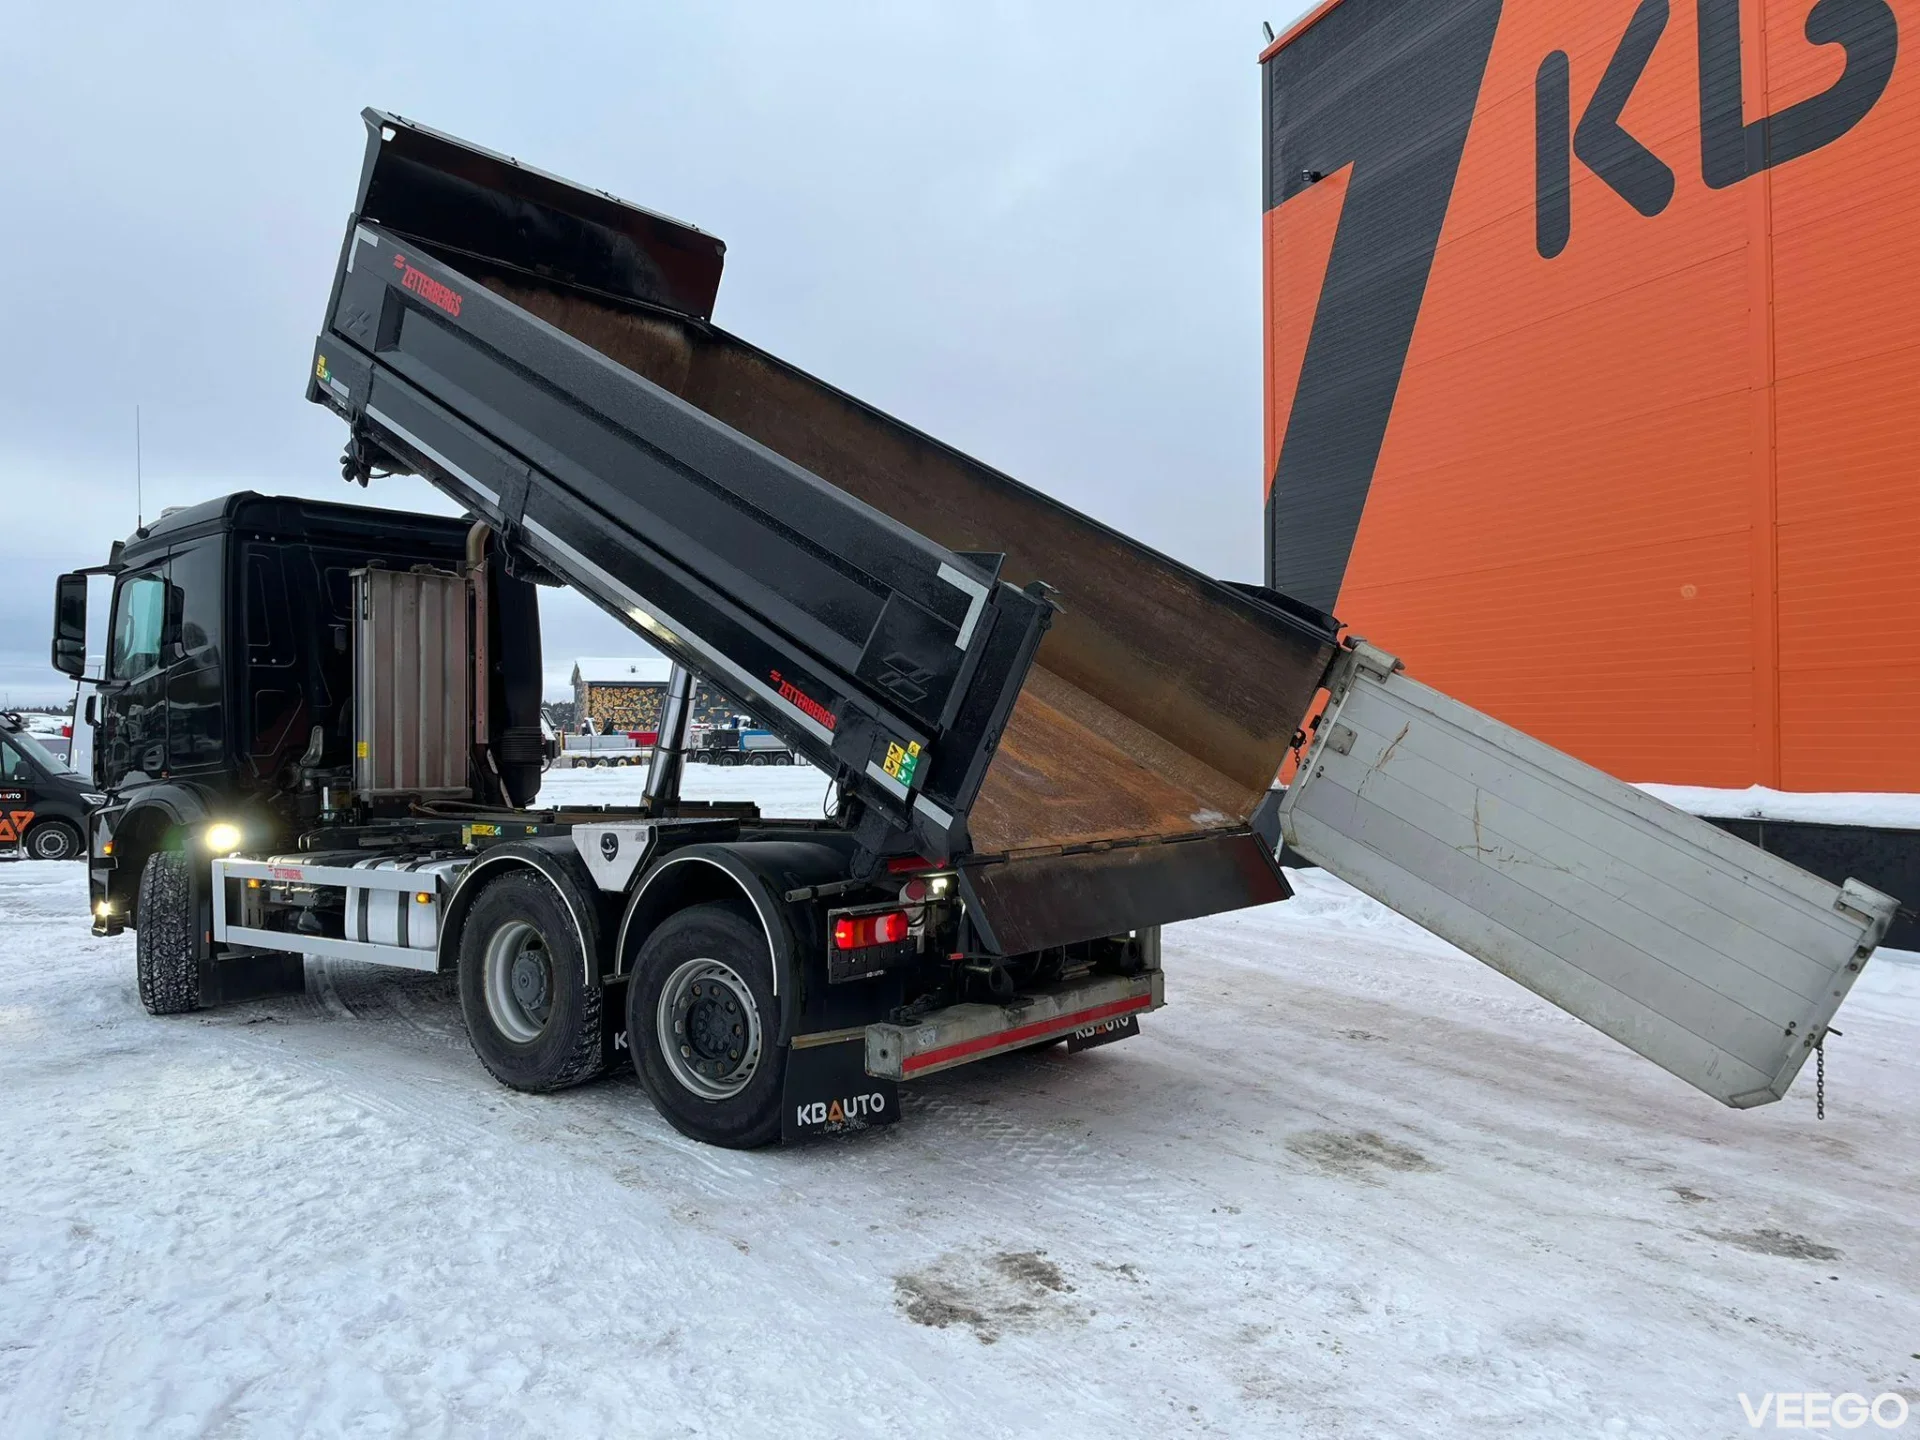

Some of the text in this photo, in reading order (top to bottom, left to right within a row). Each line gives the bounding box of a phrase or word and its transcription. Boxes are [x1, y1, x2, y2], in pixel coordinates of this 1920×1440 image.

[402, 264, 462, 316] ZETTERBERGS
[779, 680, 836, 730] ZETTERBERGS
[797, 1093, 885, 1126] KBAUTO
